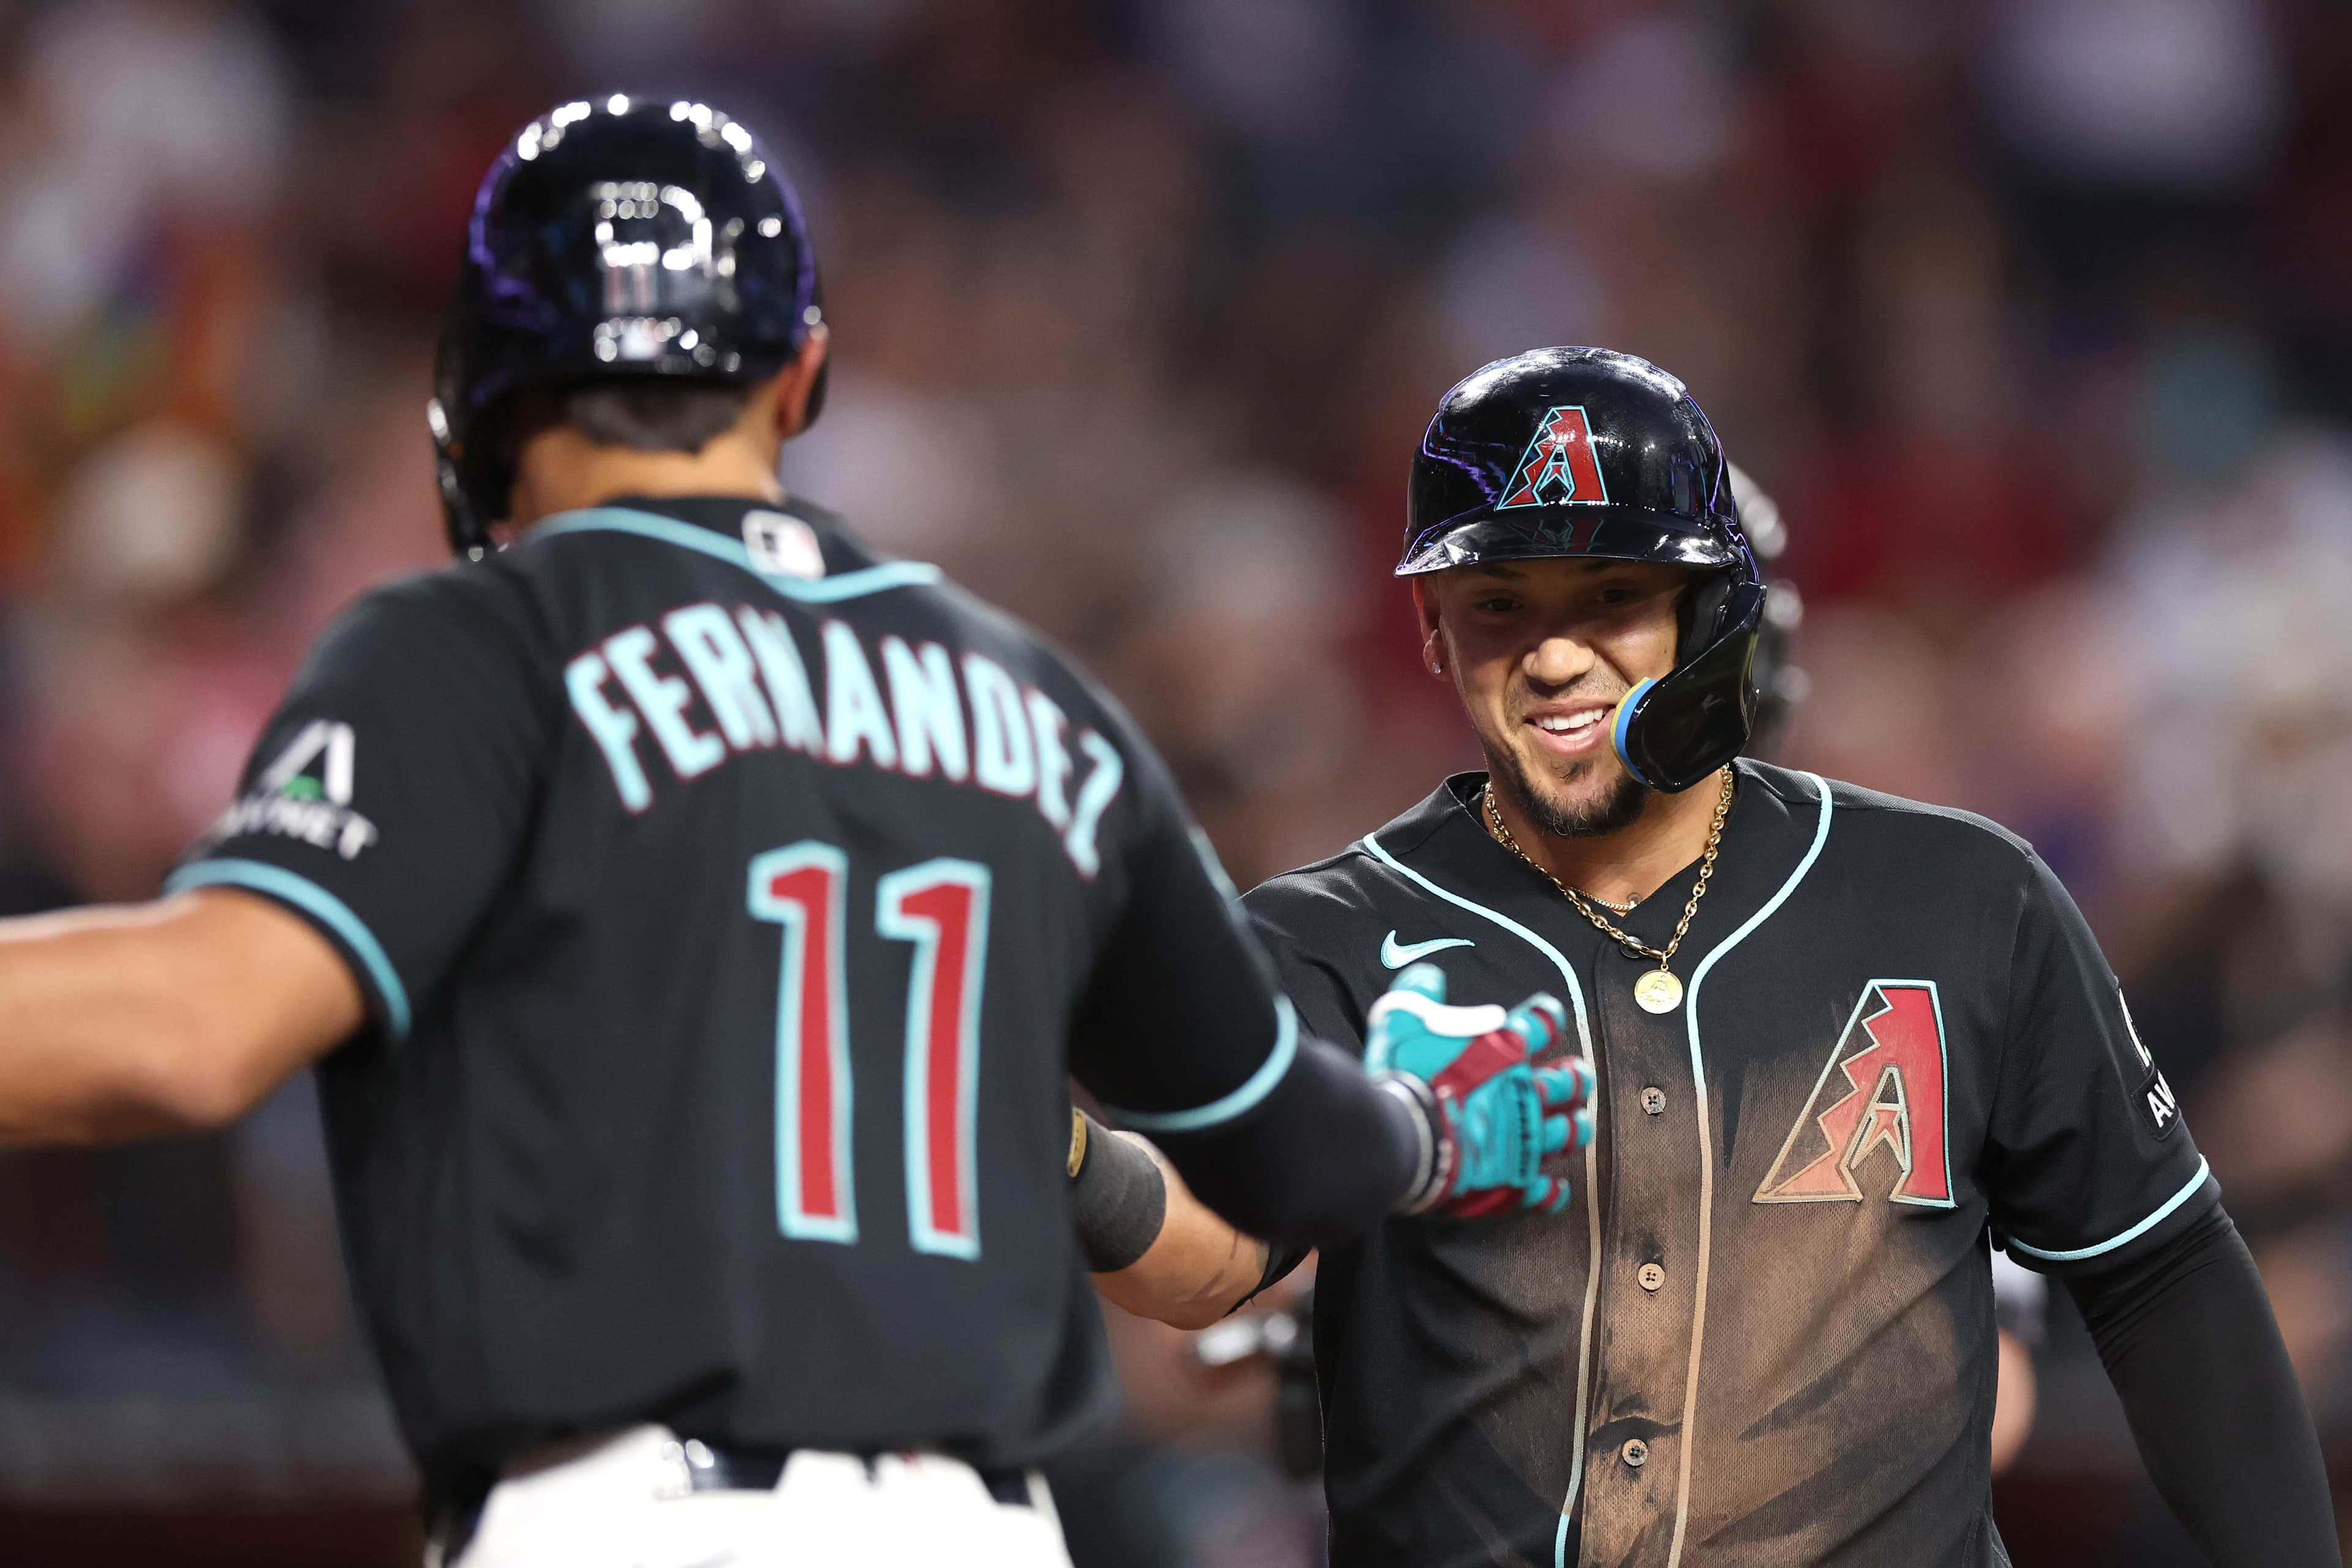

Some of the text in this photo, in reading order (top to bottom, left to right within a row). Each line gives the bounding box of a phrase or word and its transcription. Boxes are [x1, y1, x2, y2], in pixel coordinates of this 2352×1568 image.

[563, 601, 1124, 881] FERNANDEZ
[746, 838, 992, 1261] 11
[2146, 1068, 2176, 1128] AV
